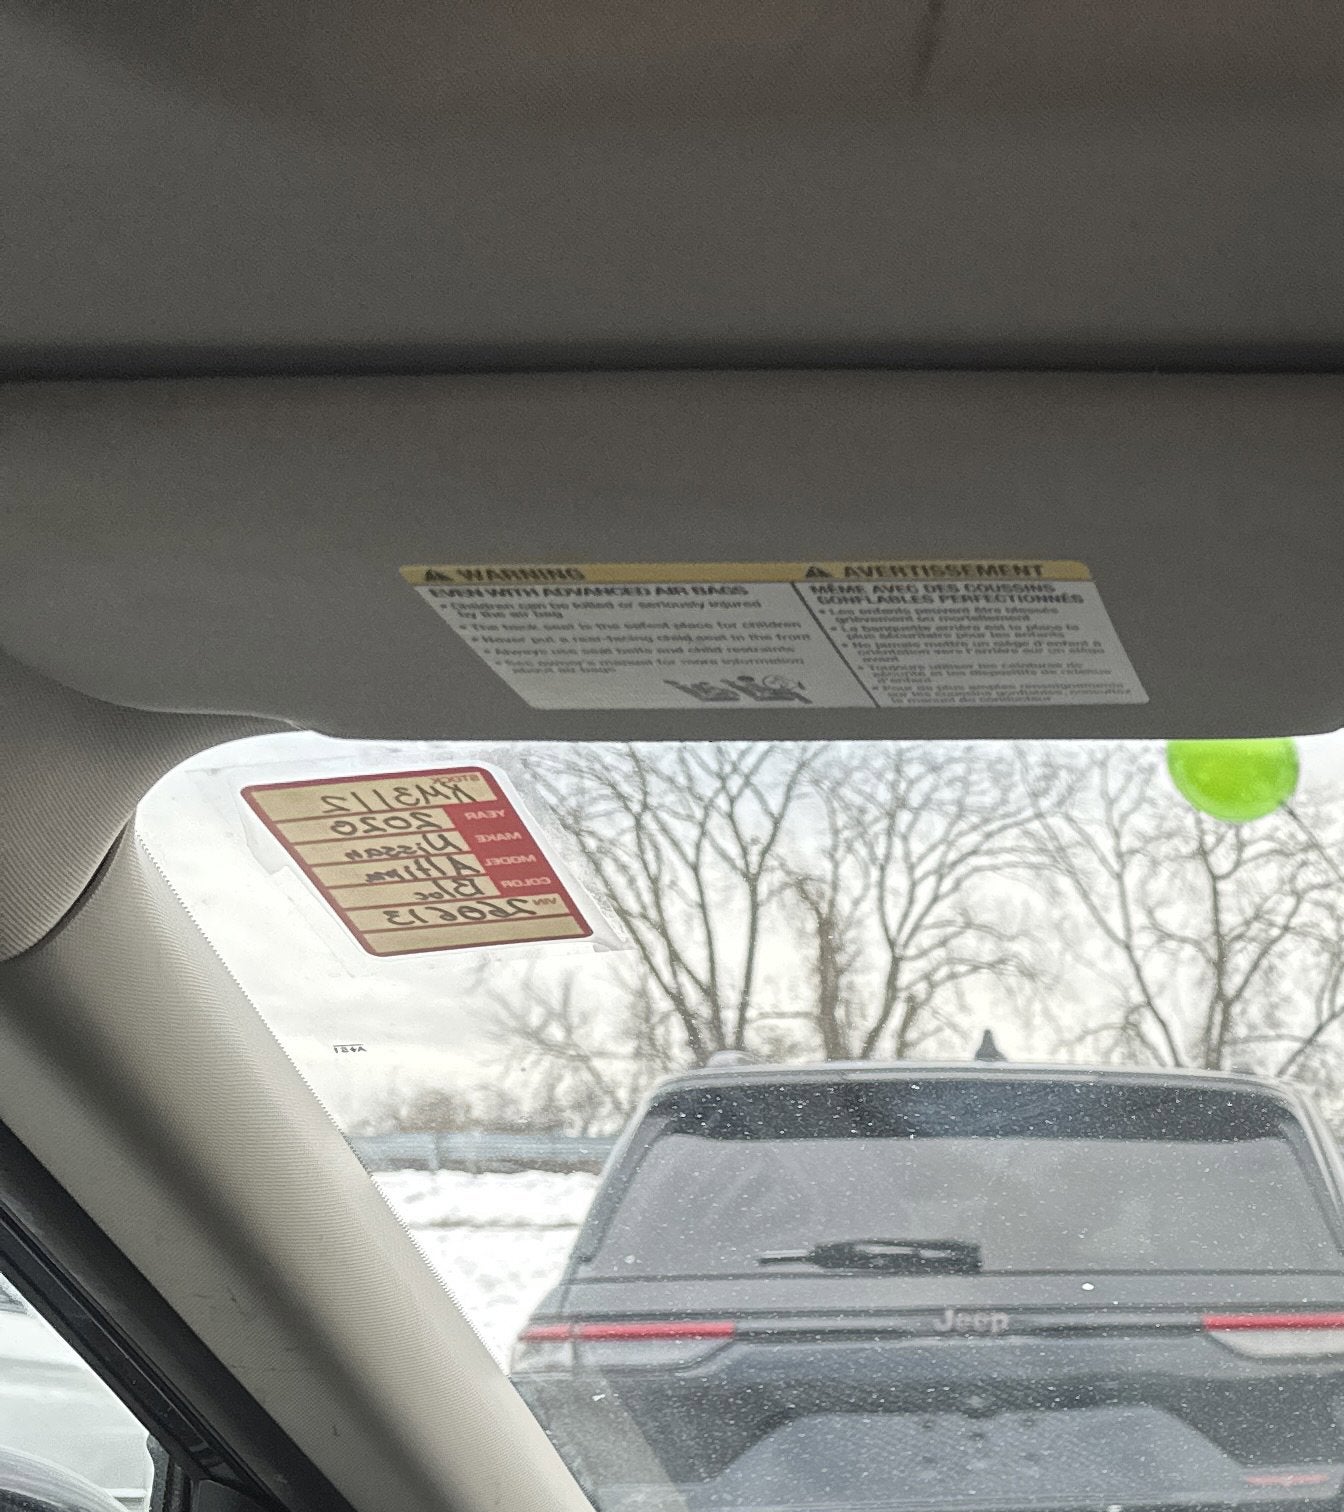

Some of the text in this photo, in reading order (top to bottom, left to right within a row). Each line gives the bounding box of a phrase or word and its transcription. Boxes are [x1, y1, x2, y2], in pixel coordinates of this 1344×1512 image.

[456, 567, 586, 582] WARNING
[843, 564, 1044, 578] AVERTISSEMENT
[932, 1309, 1010, 1333] Jeep
